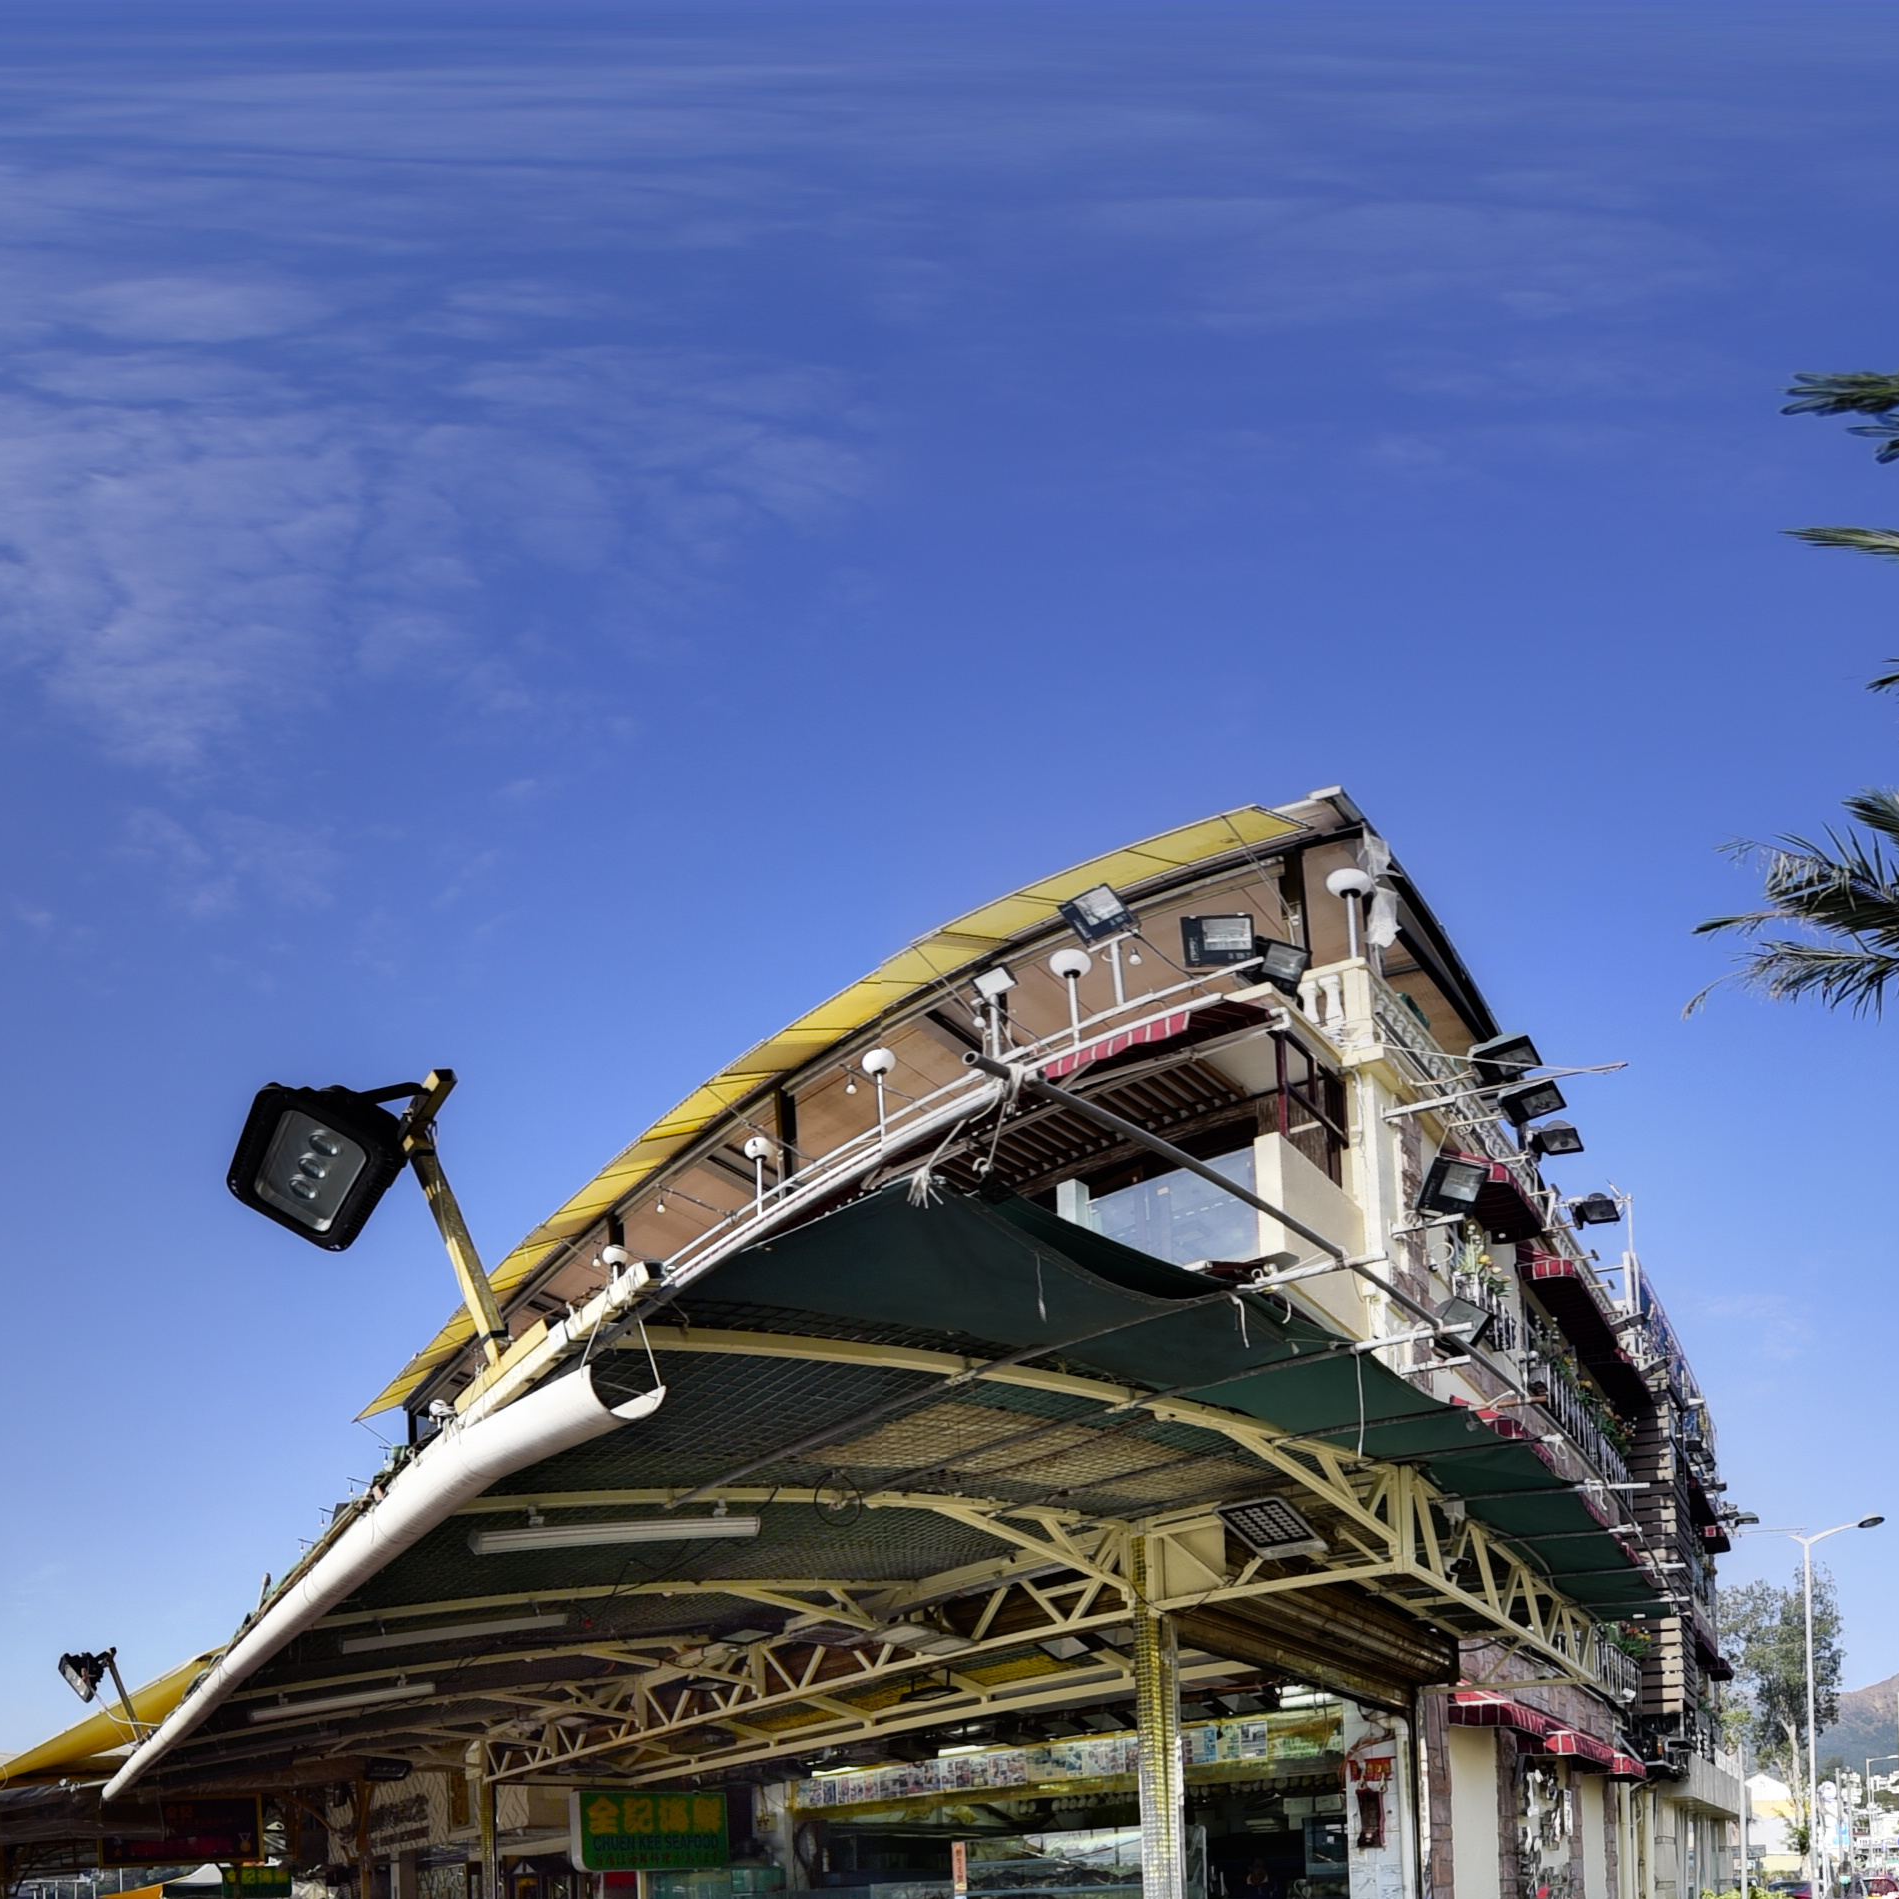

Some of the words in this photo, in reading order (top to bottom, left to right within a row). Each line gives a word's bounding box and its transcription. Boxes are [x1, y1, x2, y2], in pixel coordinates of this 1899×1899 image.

[593, 1834, 635, 1851] CHUEN
[638, 1834, 661, 1850] KEE
[665, 1834, 719, 1850] SEAFOOD
